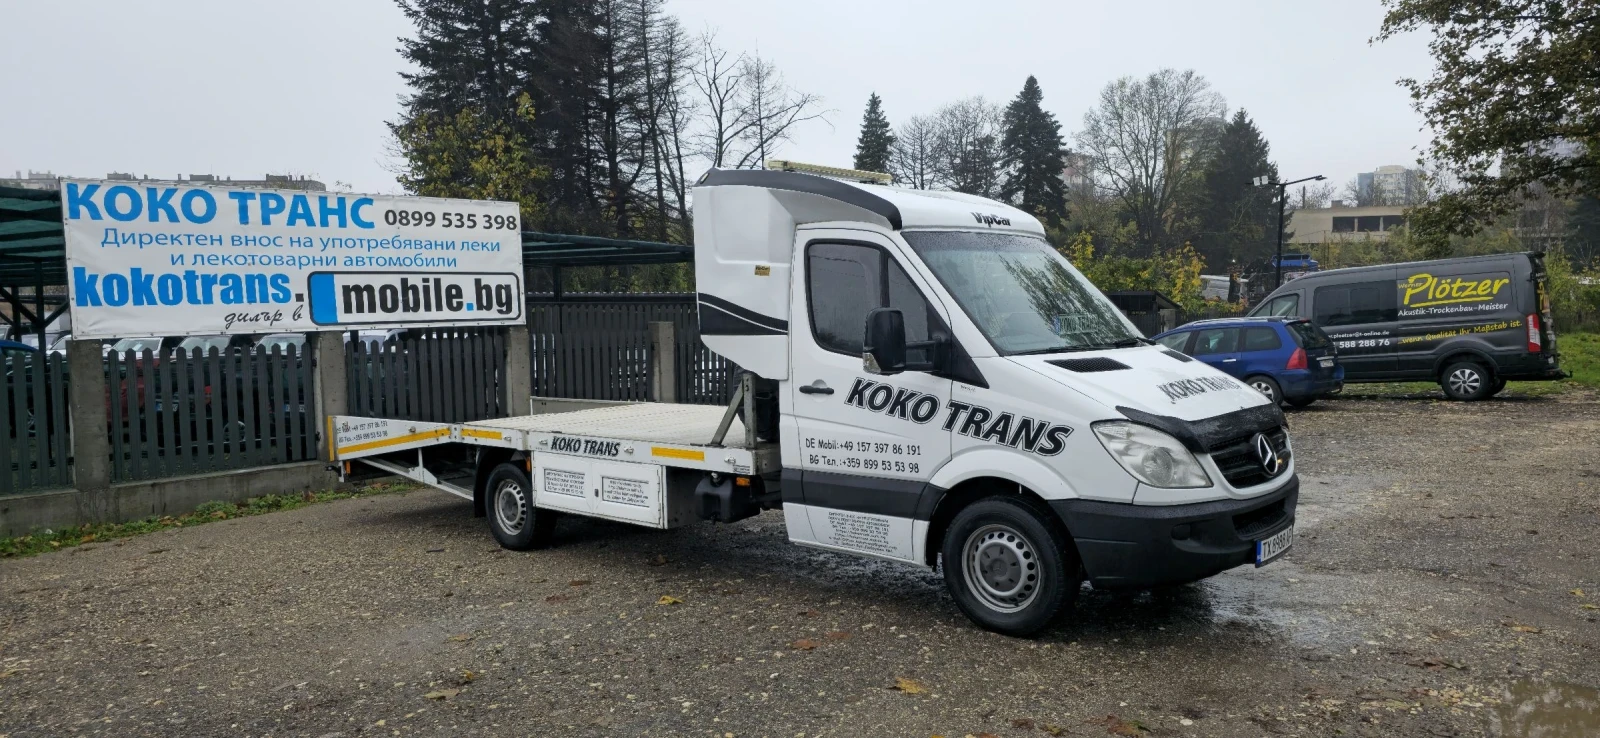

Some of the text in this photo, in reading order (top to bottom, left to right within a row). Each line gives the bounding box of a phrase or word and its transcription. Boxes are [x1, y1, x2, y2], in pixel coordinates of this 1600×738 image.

[66, 183, 375, 229] КОКО ТРАНС
[384, 209, 517, 230] 0899 535 398
[101, 228, 500, 252] Директен внос на употребявани леки
[171, 253, 457, 270] и лекотоварни автомобили
[342, 277, 513, 315] mobile.bg
[1403, 273, 1510, 305] Plötzer
[224, 309, 283, 329] дилър
[1398, 302, 1508, 317] Akustik-Trockenbau-Meister
[1426, 330, 1457, 341] Qualität
[1156, 379, 1207, 401] KOKO
[845, 377, 1073, 456] KOKO TRANS
[551, 436, 620, 457] KOKO TRANS
[805, 438, 815, 448] DE
[857, 441, 871, 452] 157
[874, 443, 889, 453] 397
[892, 444, 903, 455] 86
[906, 444, 921, 456] 191
[809, 454, 820, 465] BG
[863, 459, 879, 470] 899
[881, 460, 892, 471] 53
[895, 461, 906, 472] 53
[908, 462, 920, 473] 98
